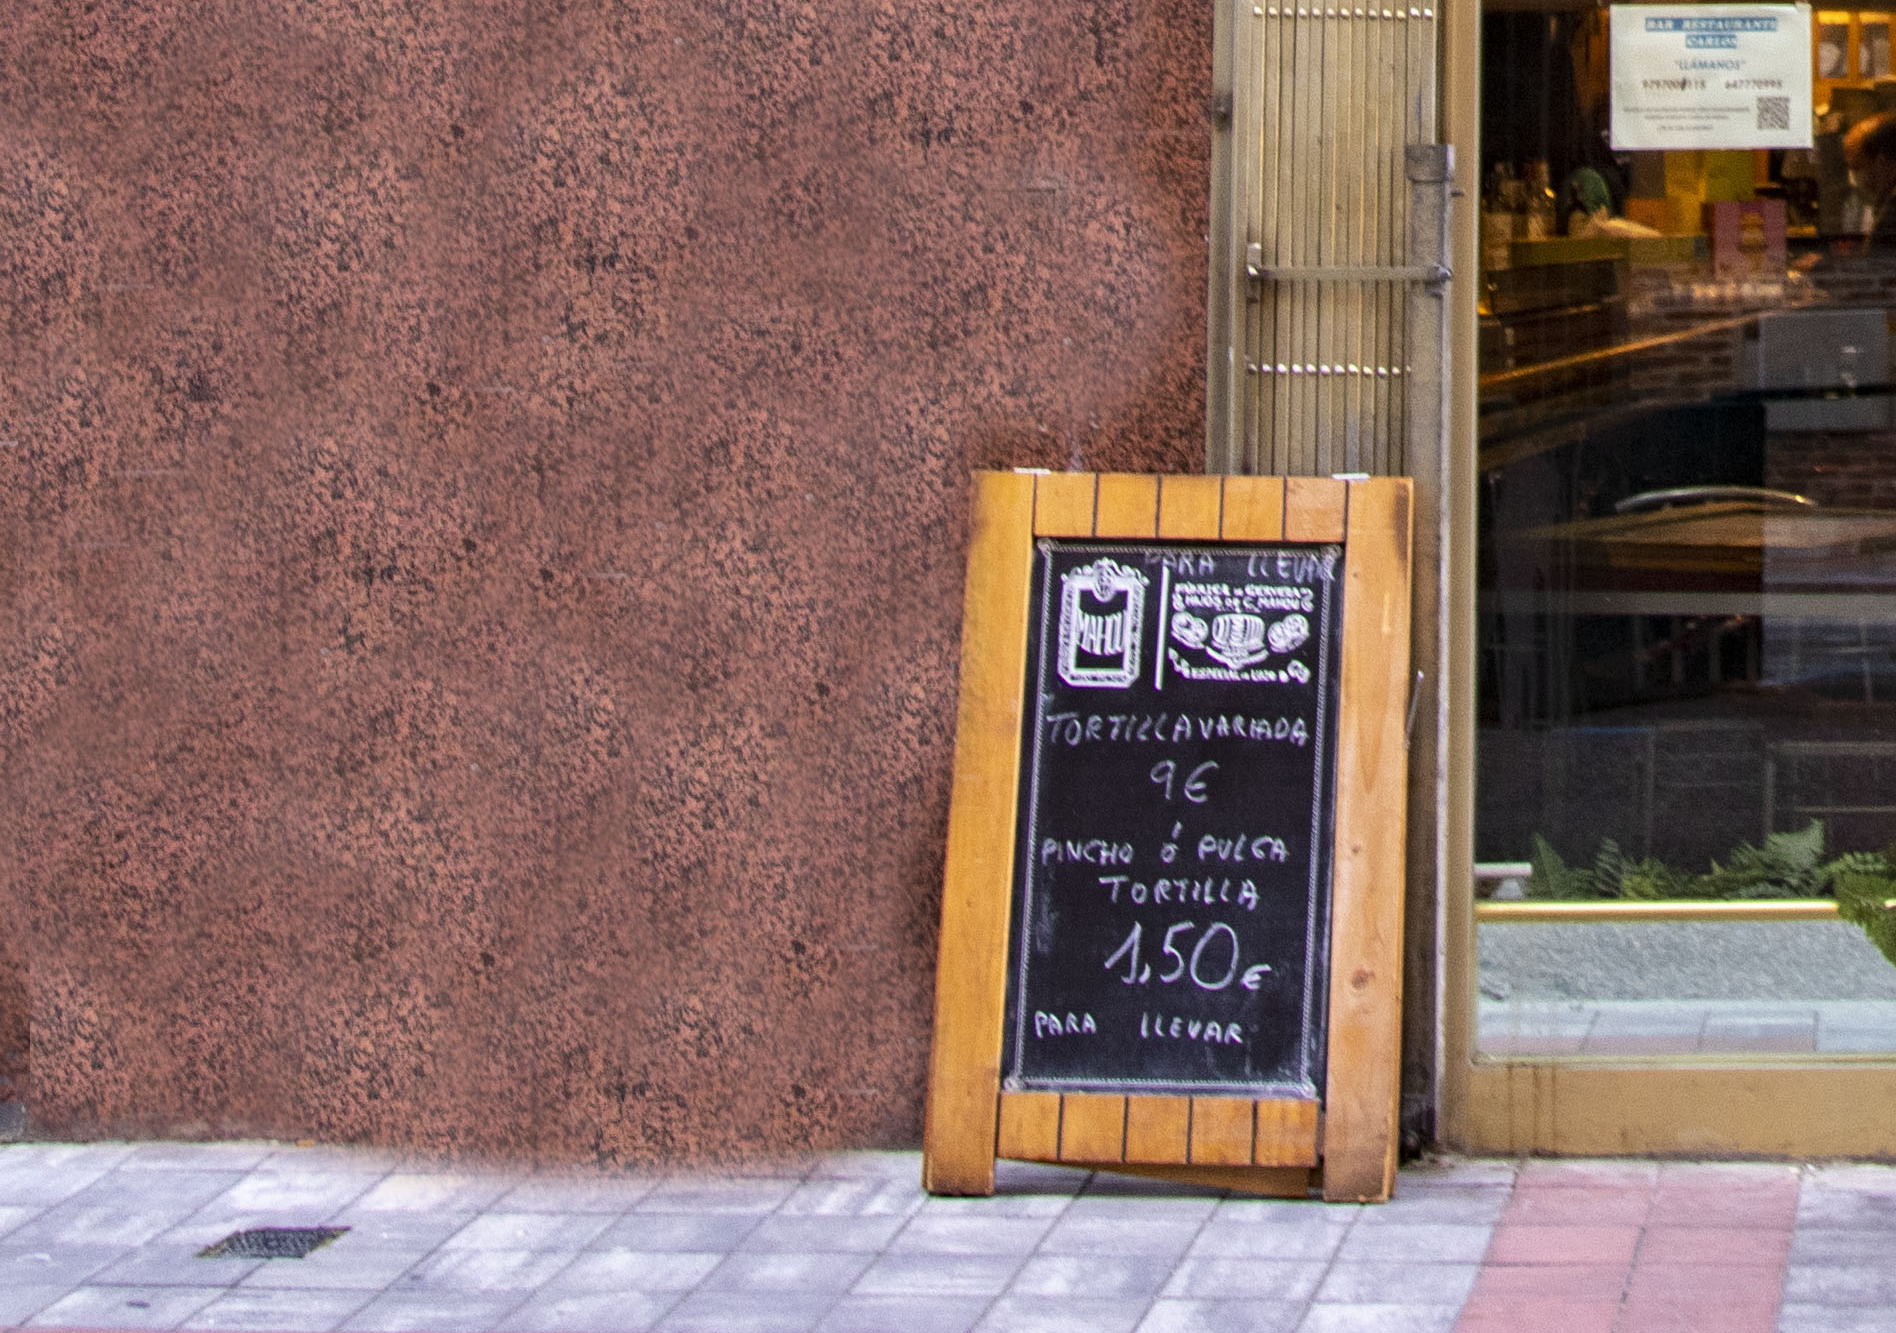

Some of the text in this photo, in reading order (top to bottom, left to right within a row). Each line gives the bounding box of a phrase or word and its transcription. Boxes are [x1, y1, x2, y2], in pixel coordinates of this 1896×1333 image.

[1646, 19, 1673, 31] BAR
[1046, 713, 1192, 746] TORTILLA
[1041, 837, 1133, 866] PINCHO
[1198, 833, 1290, 863] PULGA
[1098, 876, 1260, 911] TORTILLA
[1034, 1010, 1097, 1039] PARA
